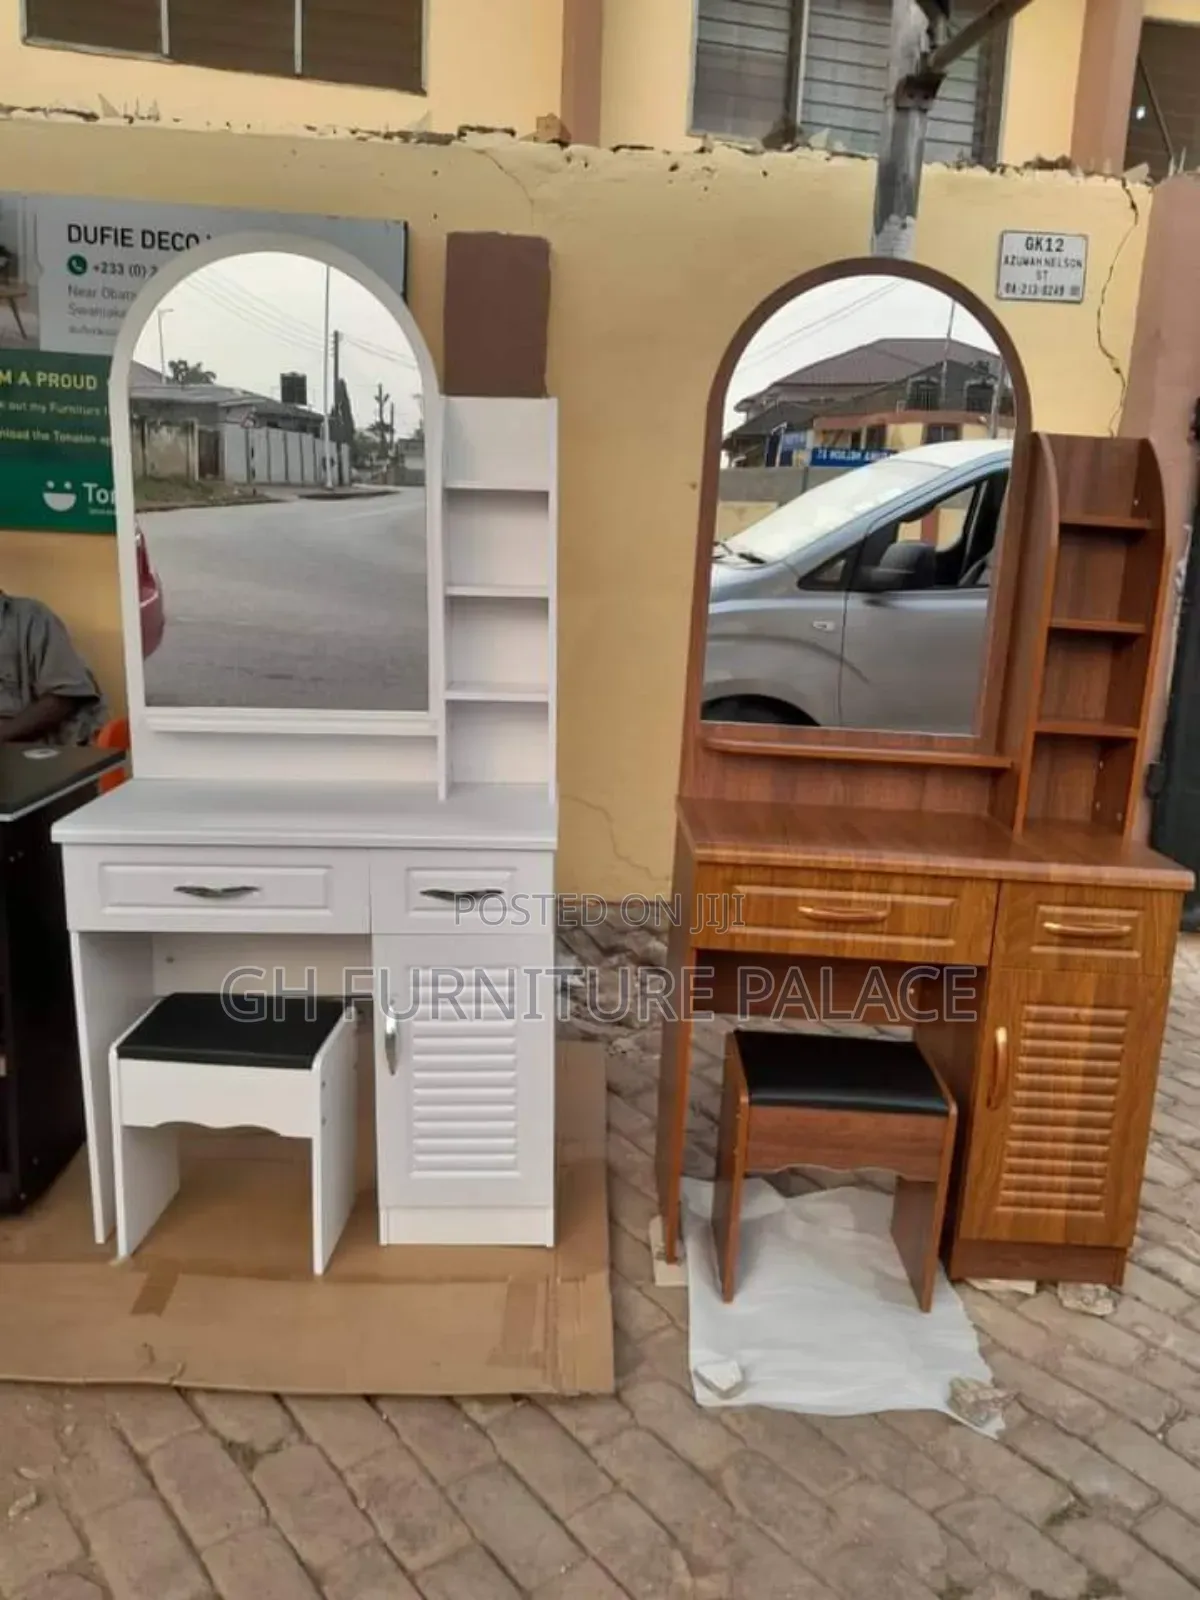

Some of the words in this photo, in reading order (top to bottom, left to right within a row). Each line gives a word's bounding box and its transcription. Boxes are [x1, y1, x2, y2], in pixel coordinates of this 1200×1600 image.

[67, 223, 134, 248] DUFIE
[1024, 236, 1065, 252] GK12
[93, 261, 124, 275] +233
[18, 371, 32, 387] A
[36, 371, 98, 391] PROUD
